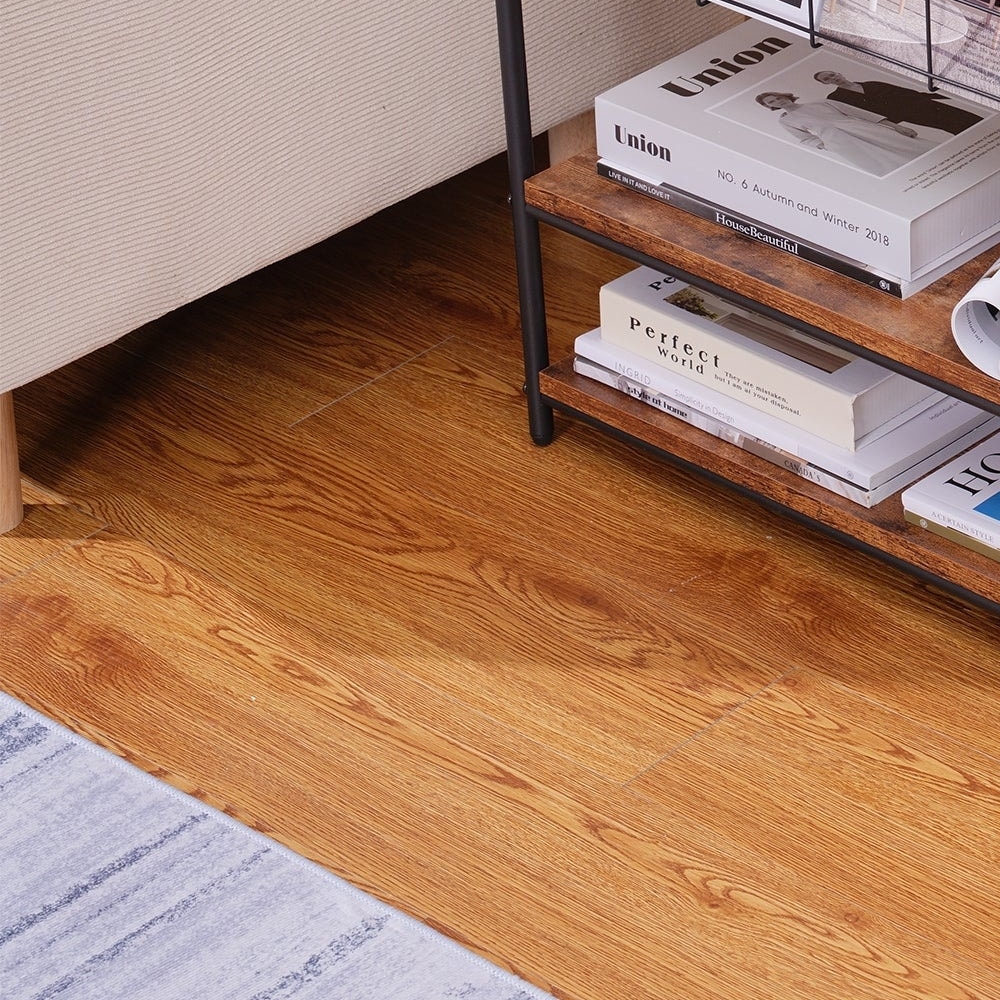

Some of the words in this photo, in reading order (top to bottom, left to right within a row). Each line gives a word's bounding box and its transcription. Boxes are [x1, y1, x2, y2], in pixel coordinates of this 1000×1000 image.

[658, 36, 794, 98] Union
[614, 124, 672, 163] Union
[608, 170, 622, 181] LIVE
[635, 181, 648, 192] AND
[648, 186, 664, 199] LOVE
[664, 193, 671, 201] IT
[717, 168, 736, 185] NO.
[741, 179, 749, 190] 6
[753, 184, 795, 208] Autumn
[796, 202, 818, 217] and
[822, 211, 860, 233] Winter
[865, 227, 890, 247] 2018
[630, 316, 719, 369] Perfect
[614, 362, 652, 386] INGRID
[714, 374, 727, 384] but
[732, 382, 743, 391] am
[753, 391, 768, 402] your
[724, 371, 742, 383] They
[743, 380, 754, 389] are
[784, 460, 821, 482] CANADA'S
